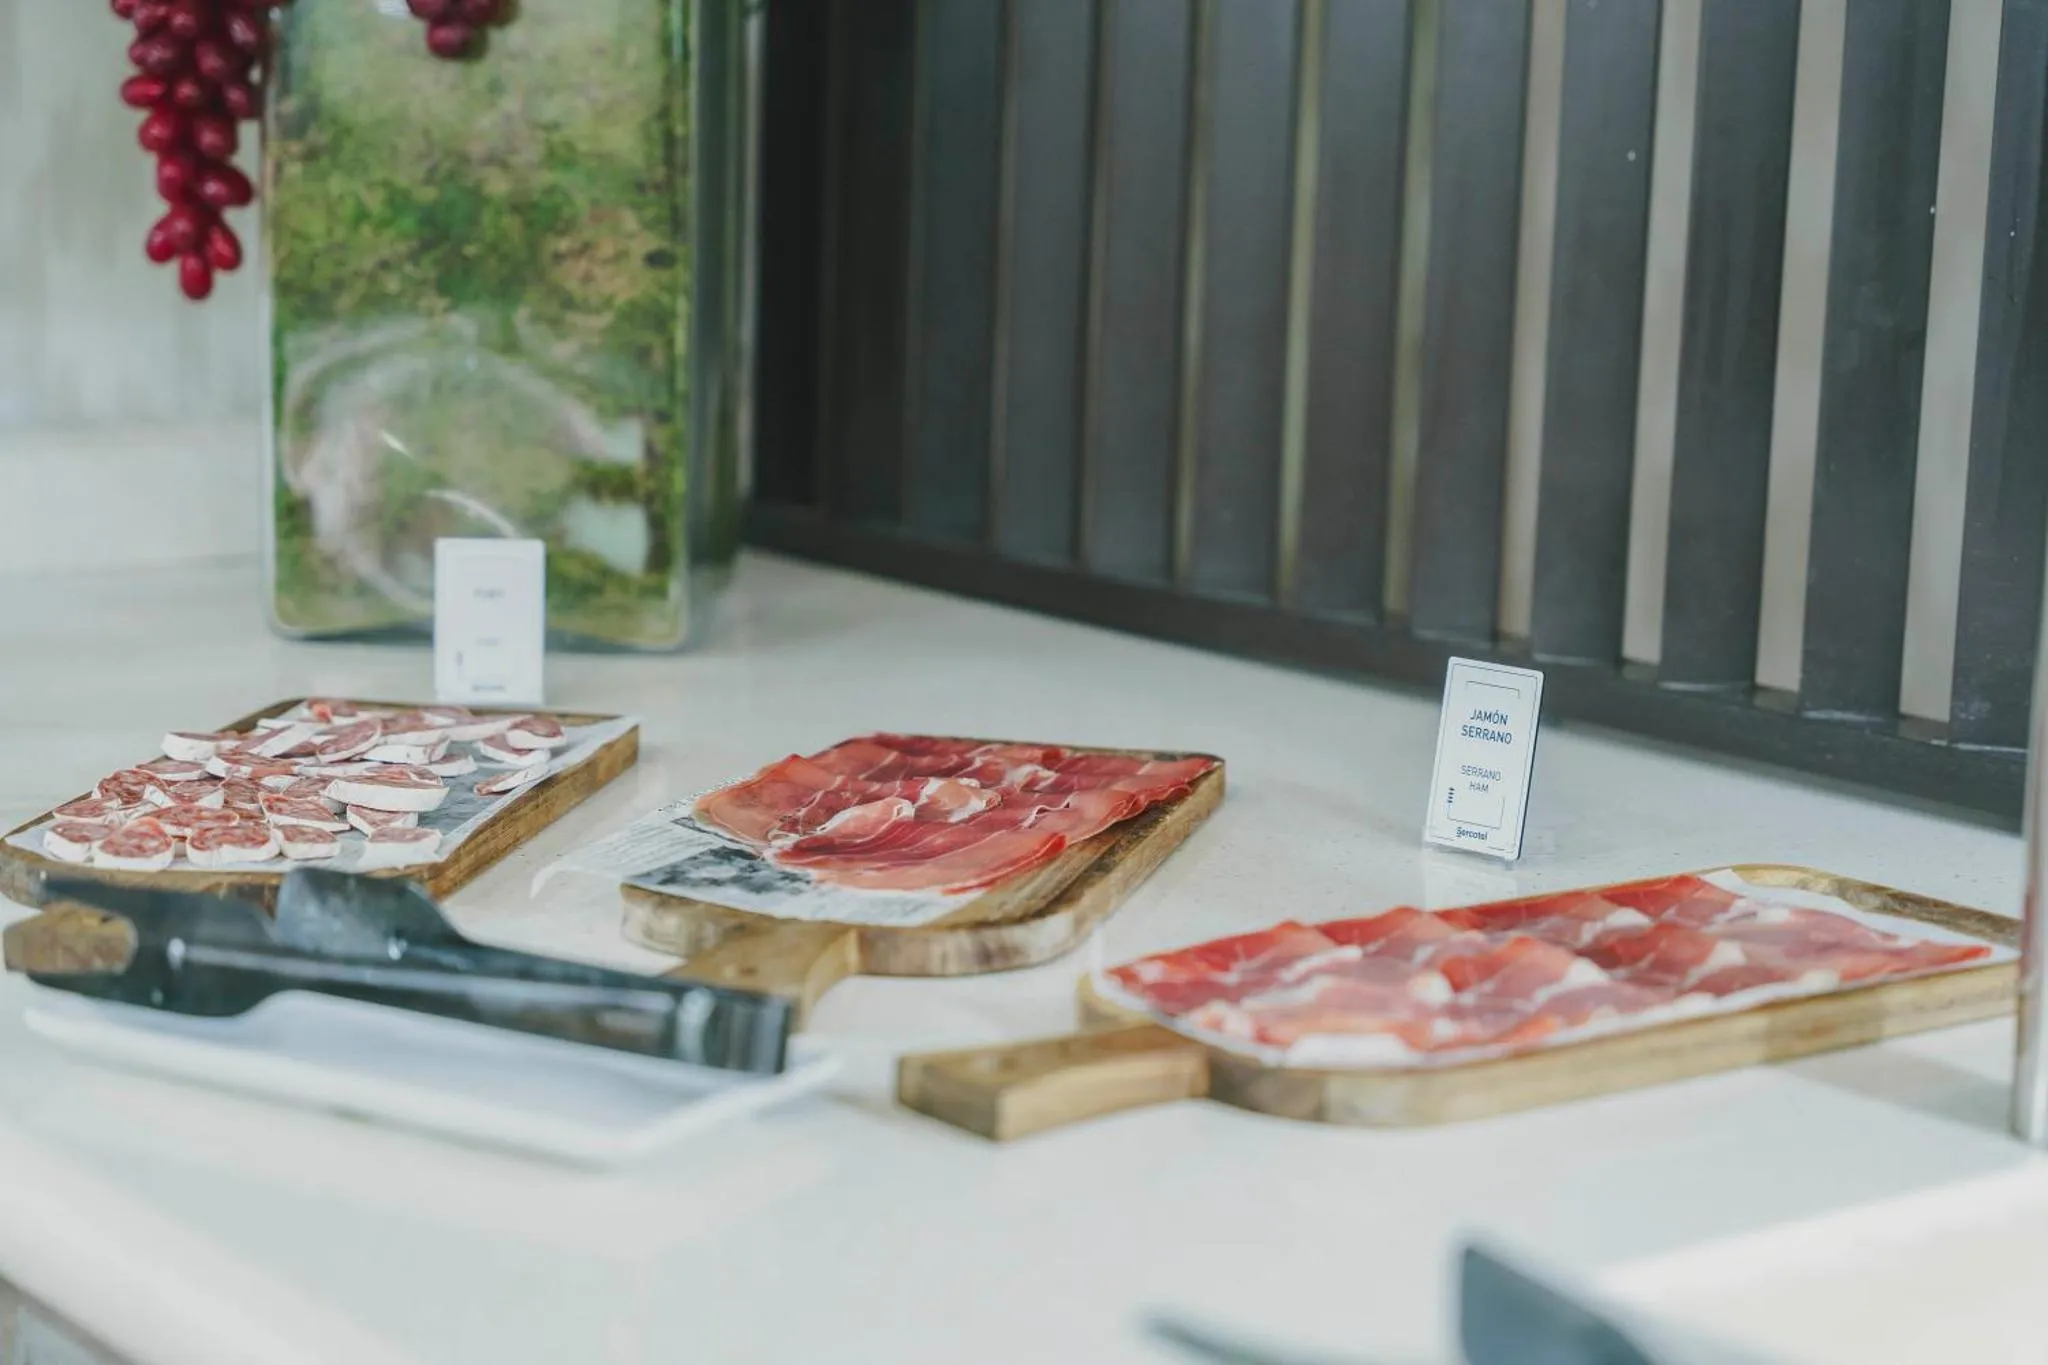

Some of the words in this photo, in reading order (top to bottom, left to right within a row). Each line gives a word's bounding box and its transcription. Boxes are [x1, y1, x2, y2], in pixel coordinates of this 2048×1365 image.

[1470, 709, 1508, 726] JAMÓN
[1461, 725, 1512, 744] SERRANO
[1460, 765, 1501, 781] SERRANO
[1469, 781, 1489, 793] HAM
